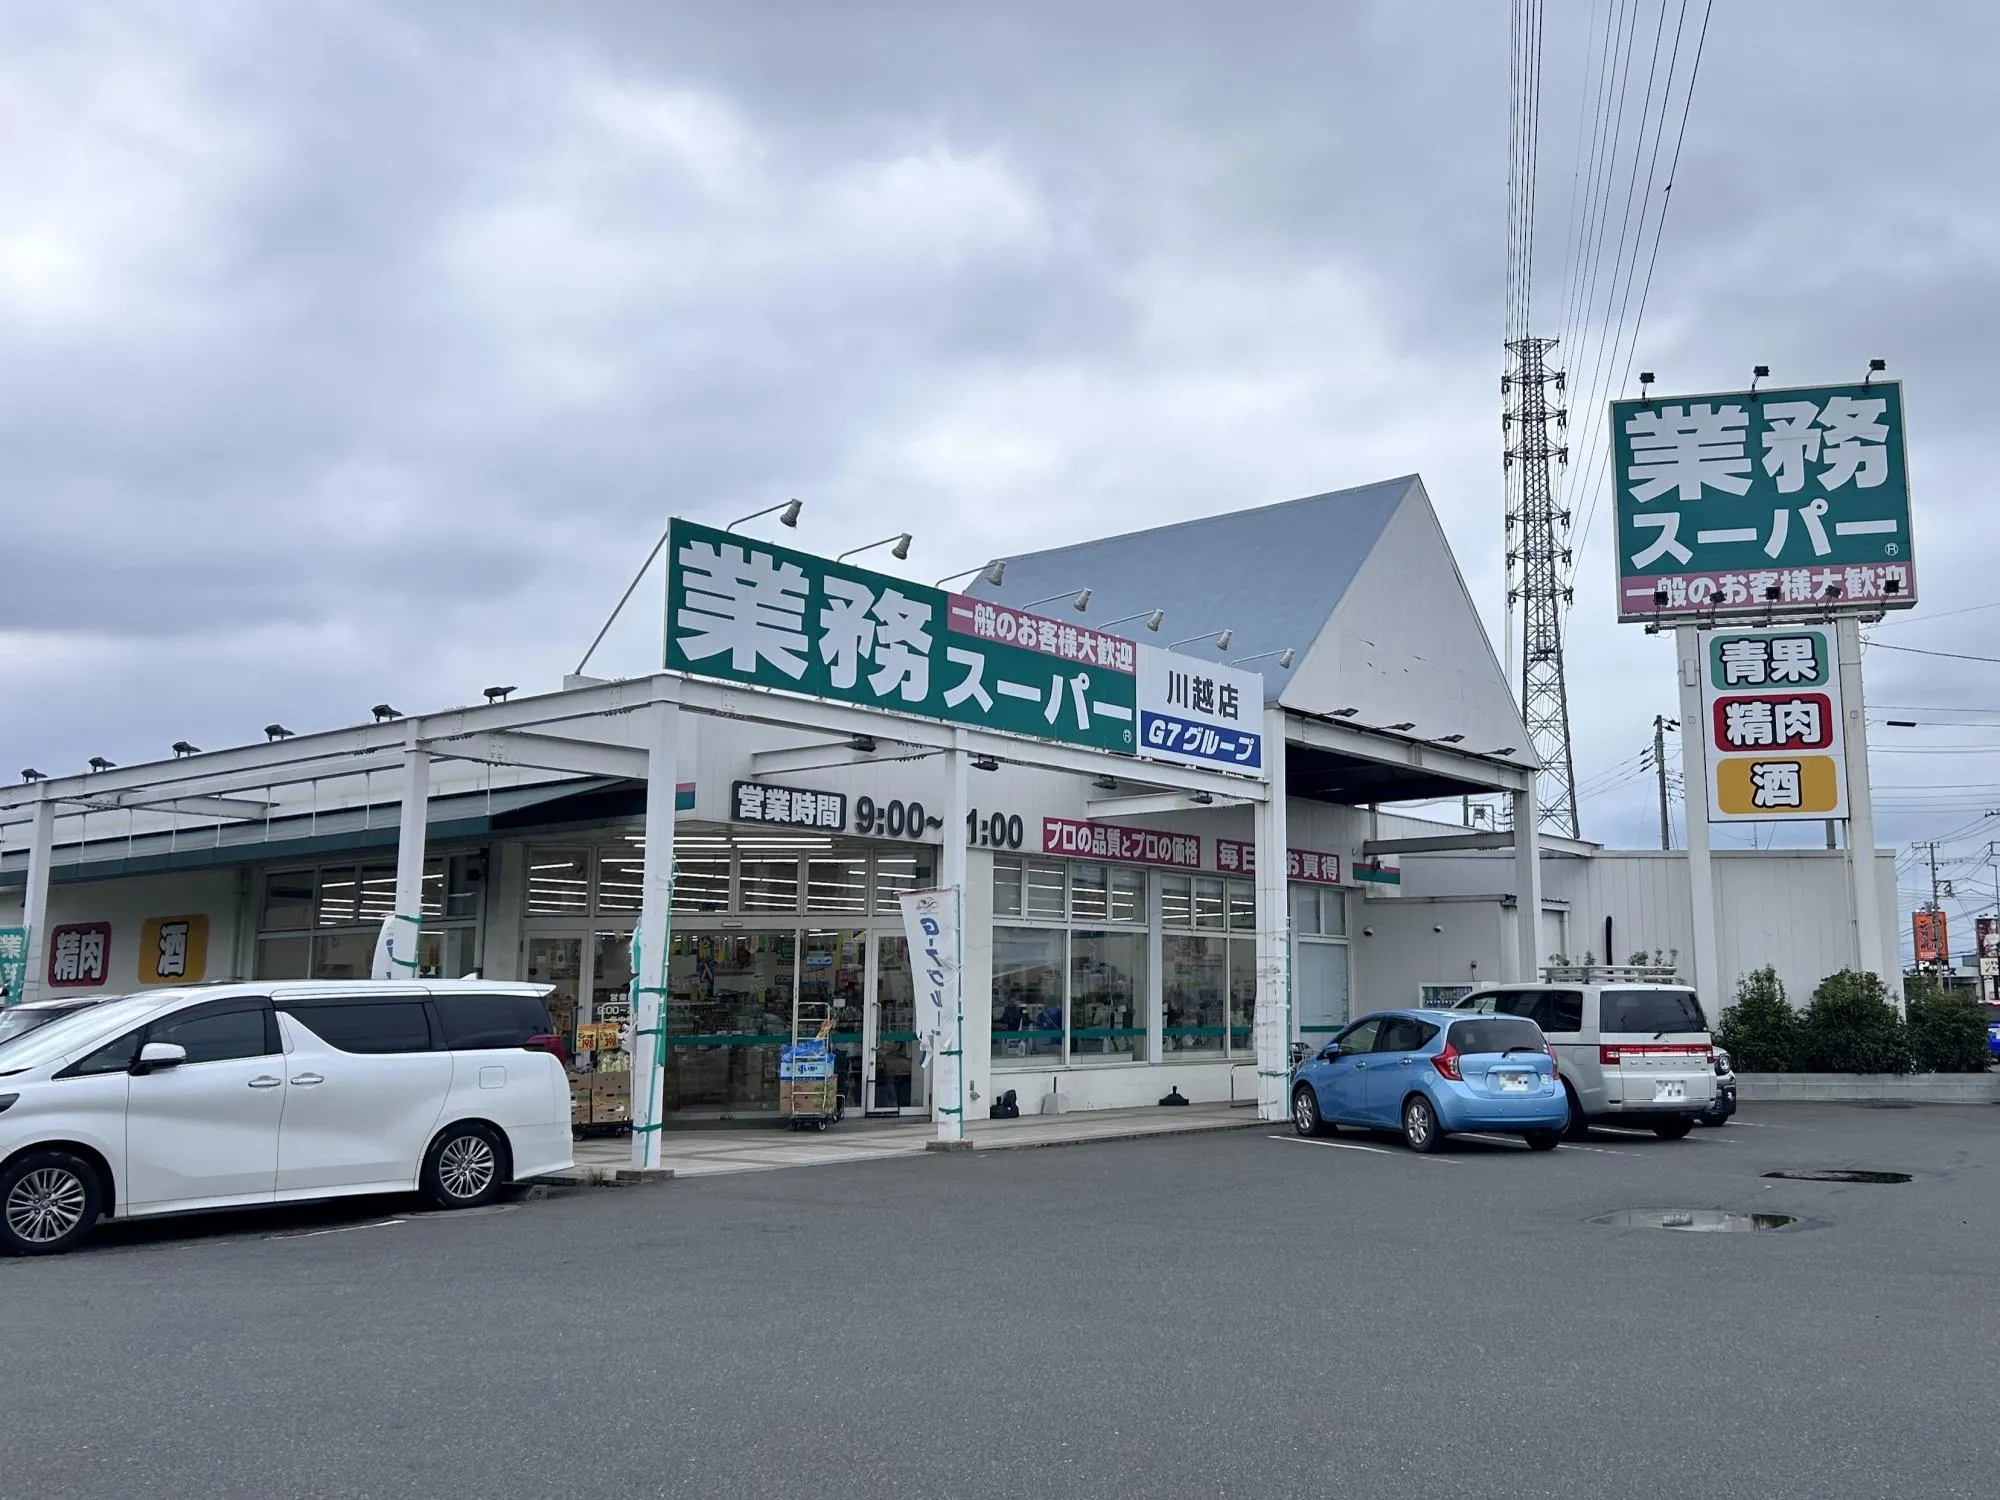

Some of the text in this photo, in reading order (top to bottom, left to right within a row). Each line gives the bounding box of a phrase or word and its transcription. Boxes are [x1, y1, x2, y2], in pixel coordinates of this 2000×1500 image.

[1625, 396, 1890, 503] 業務
[1630, 498, 1897, 570] スーパー
[951, 602, 1134, 673] 一般のお客様大歓迎
[1721, 637, 1818, 685] 青果
[1167, 671, 1239, 720] 川越店
[1148, 719, 1254, 760] G7グループ
[1726, 700, 1821, 746] 精肉
[738, 785, 841, 827] 営業時間
[1752, 762, 1801, 807] 酒
[1046, 822, 1198, 866] プロの品質とプロの価格
[1219, 842, 1338, 880] 毎日お買得
[54, 930, 104, 980] 精肉
[158, 923, 187, 976] 酒
